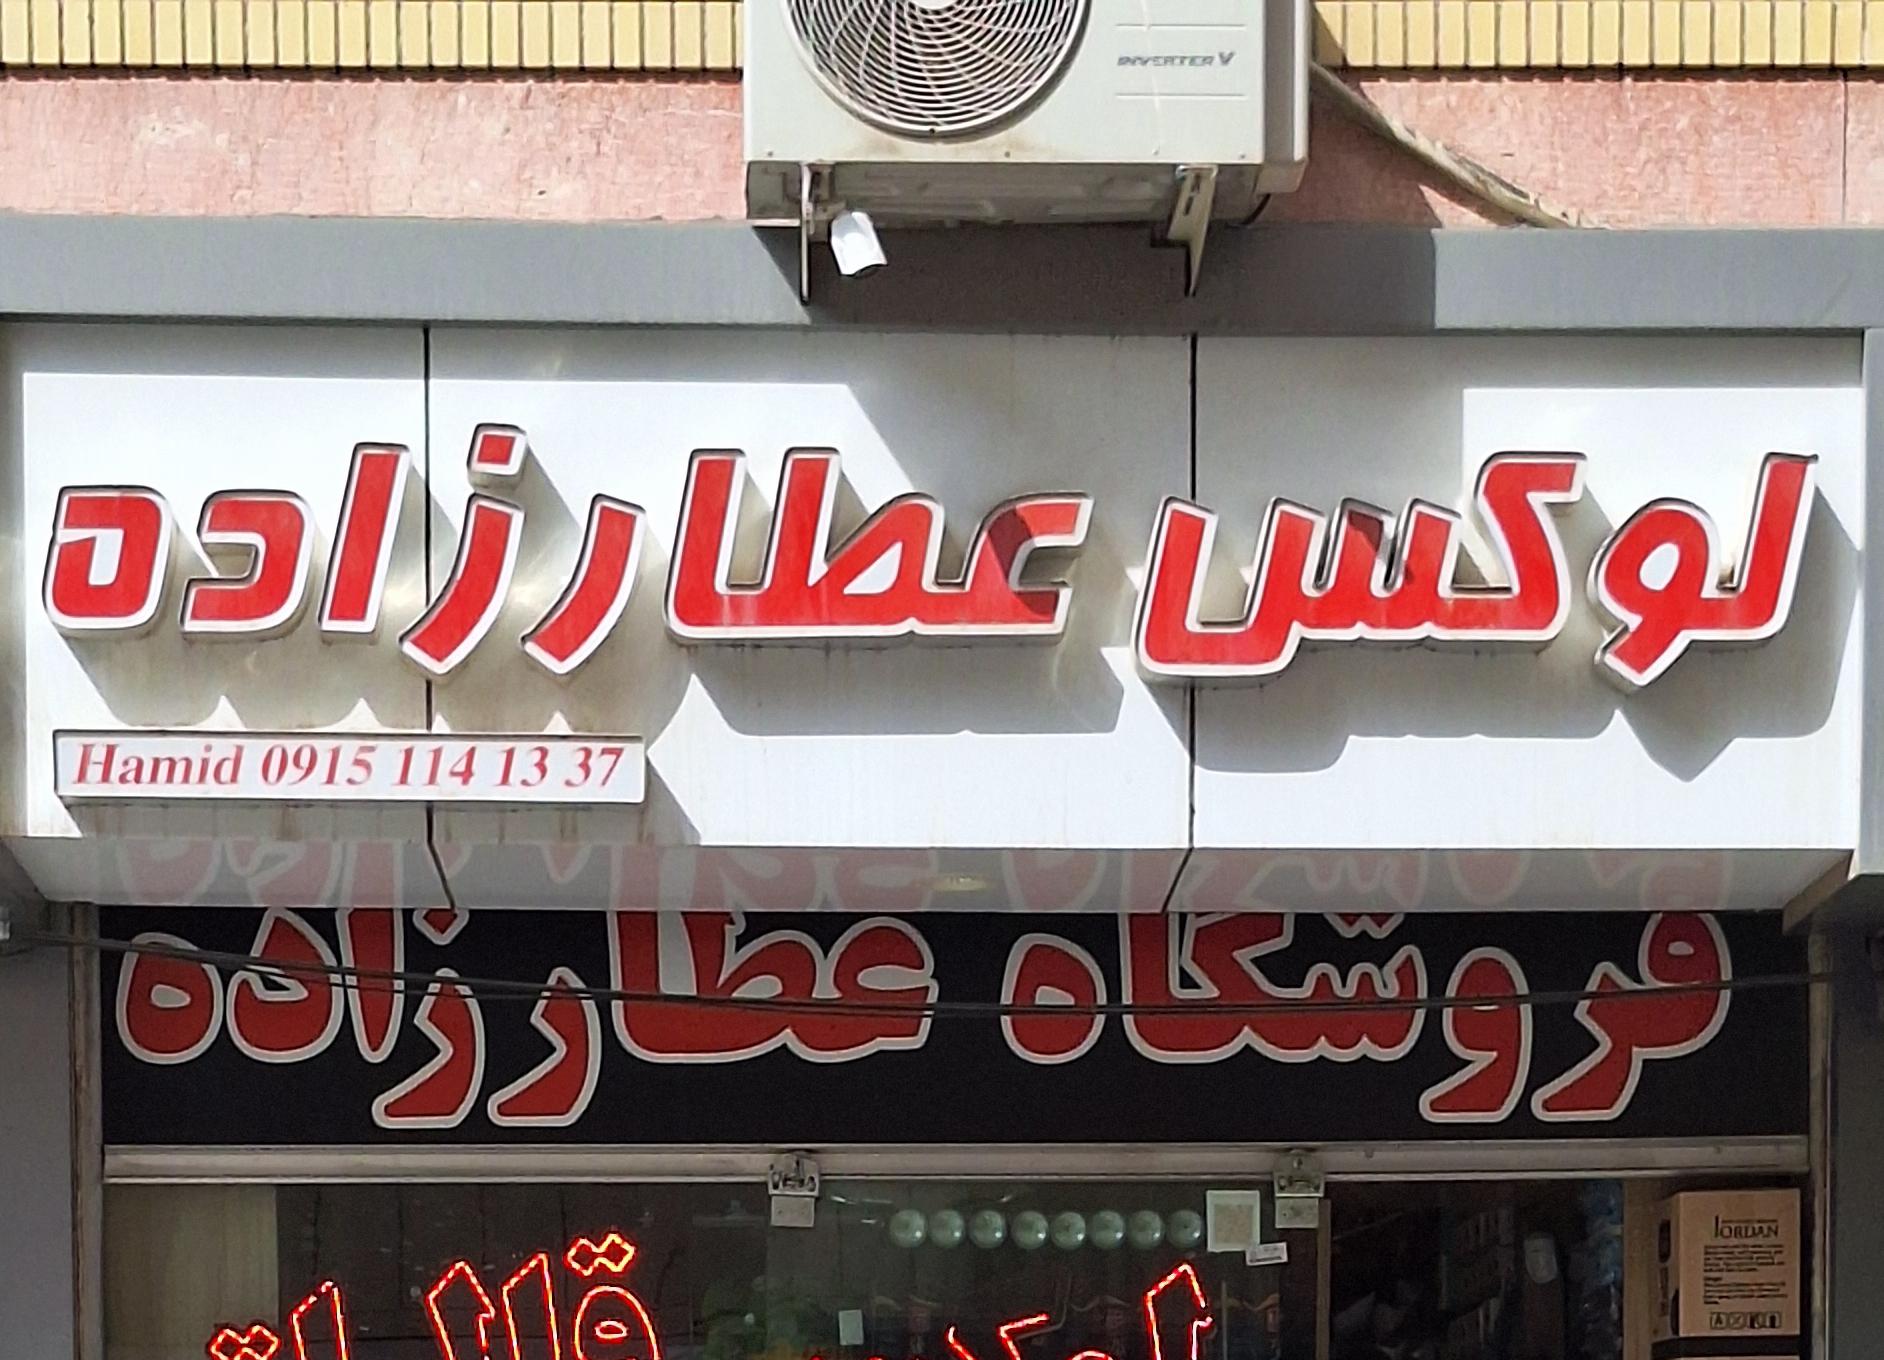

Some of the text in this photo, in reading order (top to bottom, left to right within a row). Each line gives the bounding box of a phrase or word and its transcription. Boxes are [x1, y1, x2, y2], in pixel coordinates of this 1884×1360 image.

[1117, 52, 1235, 66] INVERTER V
[43, 421, 1818, 688] لوکس عطارزاده
[73, 743, 624, 788] Hamid 0915 114 13 37
[1713, 1215, 1779, 1239] JORDAN
